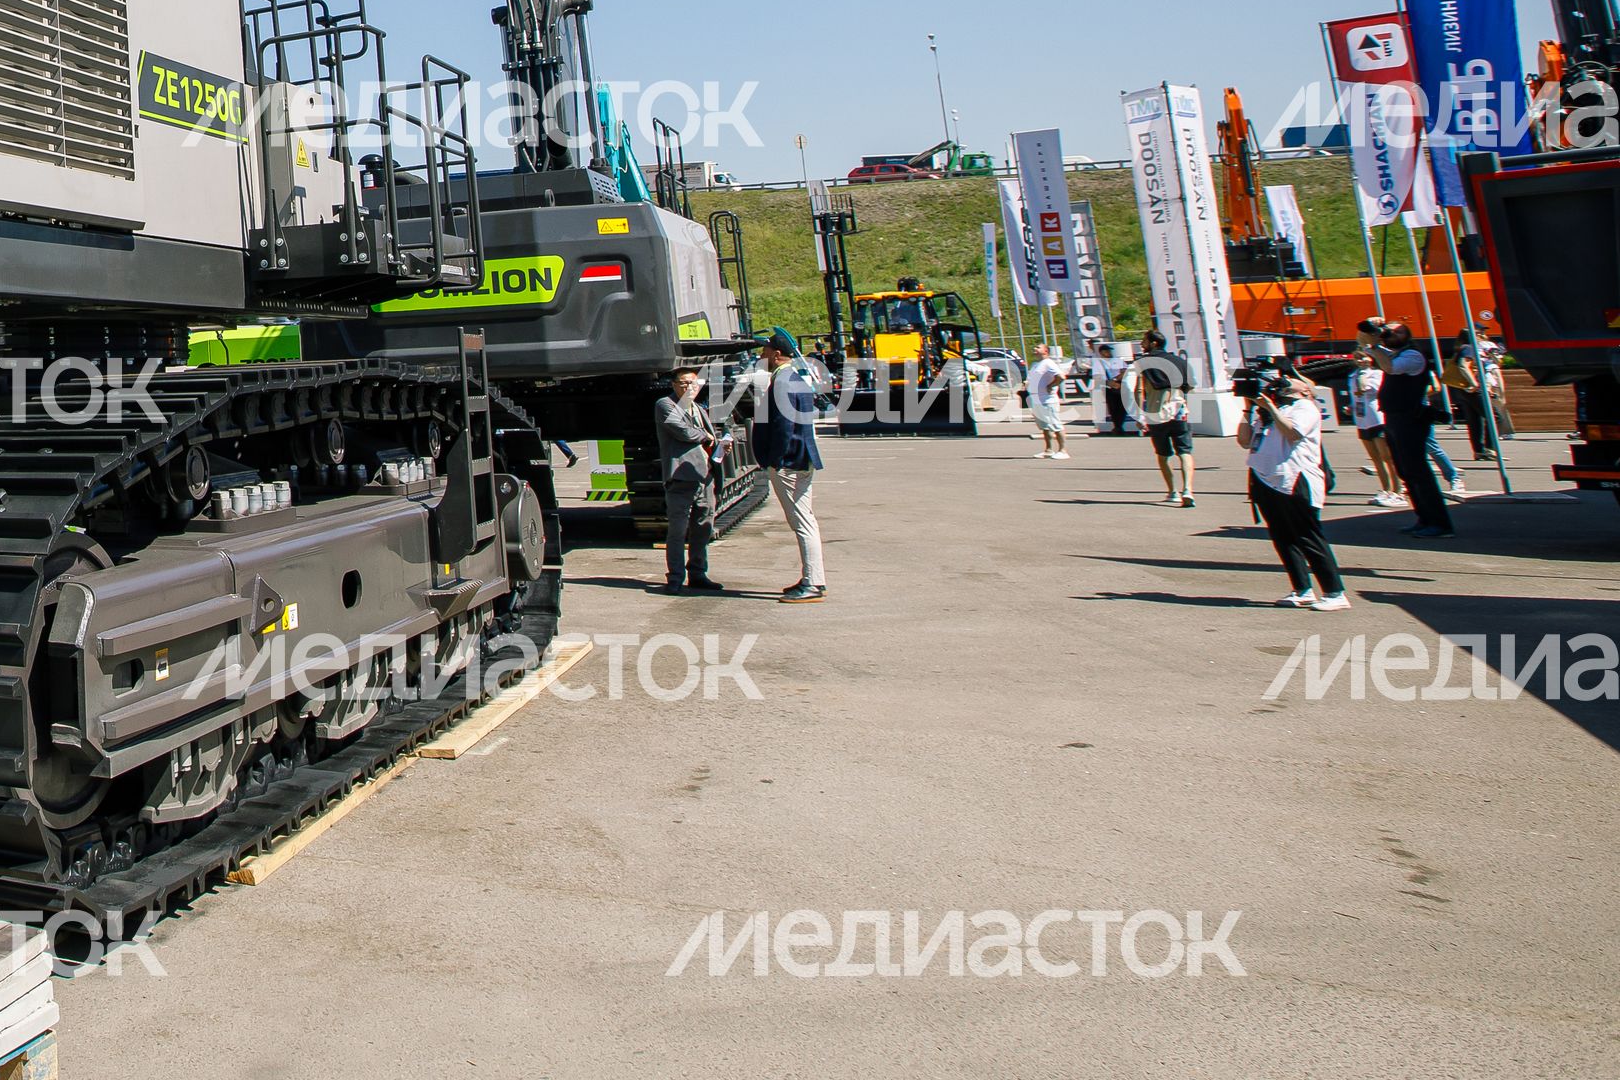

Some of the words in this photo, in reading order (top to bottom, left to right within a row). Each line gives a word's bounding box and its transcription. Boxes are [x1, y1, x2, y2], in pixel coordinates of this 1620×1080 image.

[152, 65, 242, 125] ZE1250G
[1447, 58, 1499, 132] ВТБ
[1138, 132, 1165, 224] DOOSAN
[1369, 92, 1394, 190] SHACMAN
[1165, 270, 1188, 361] DEVELO
